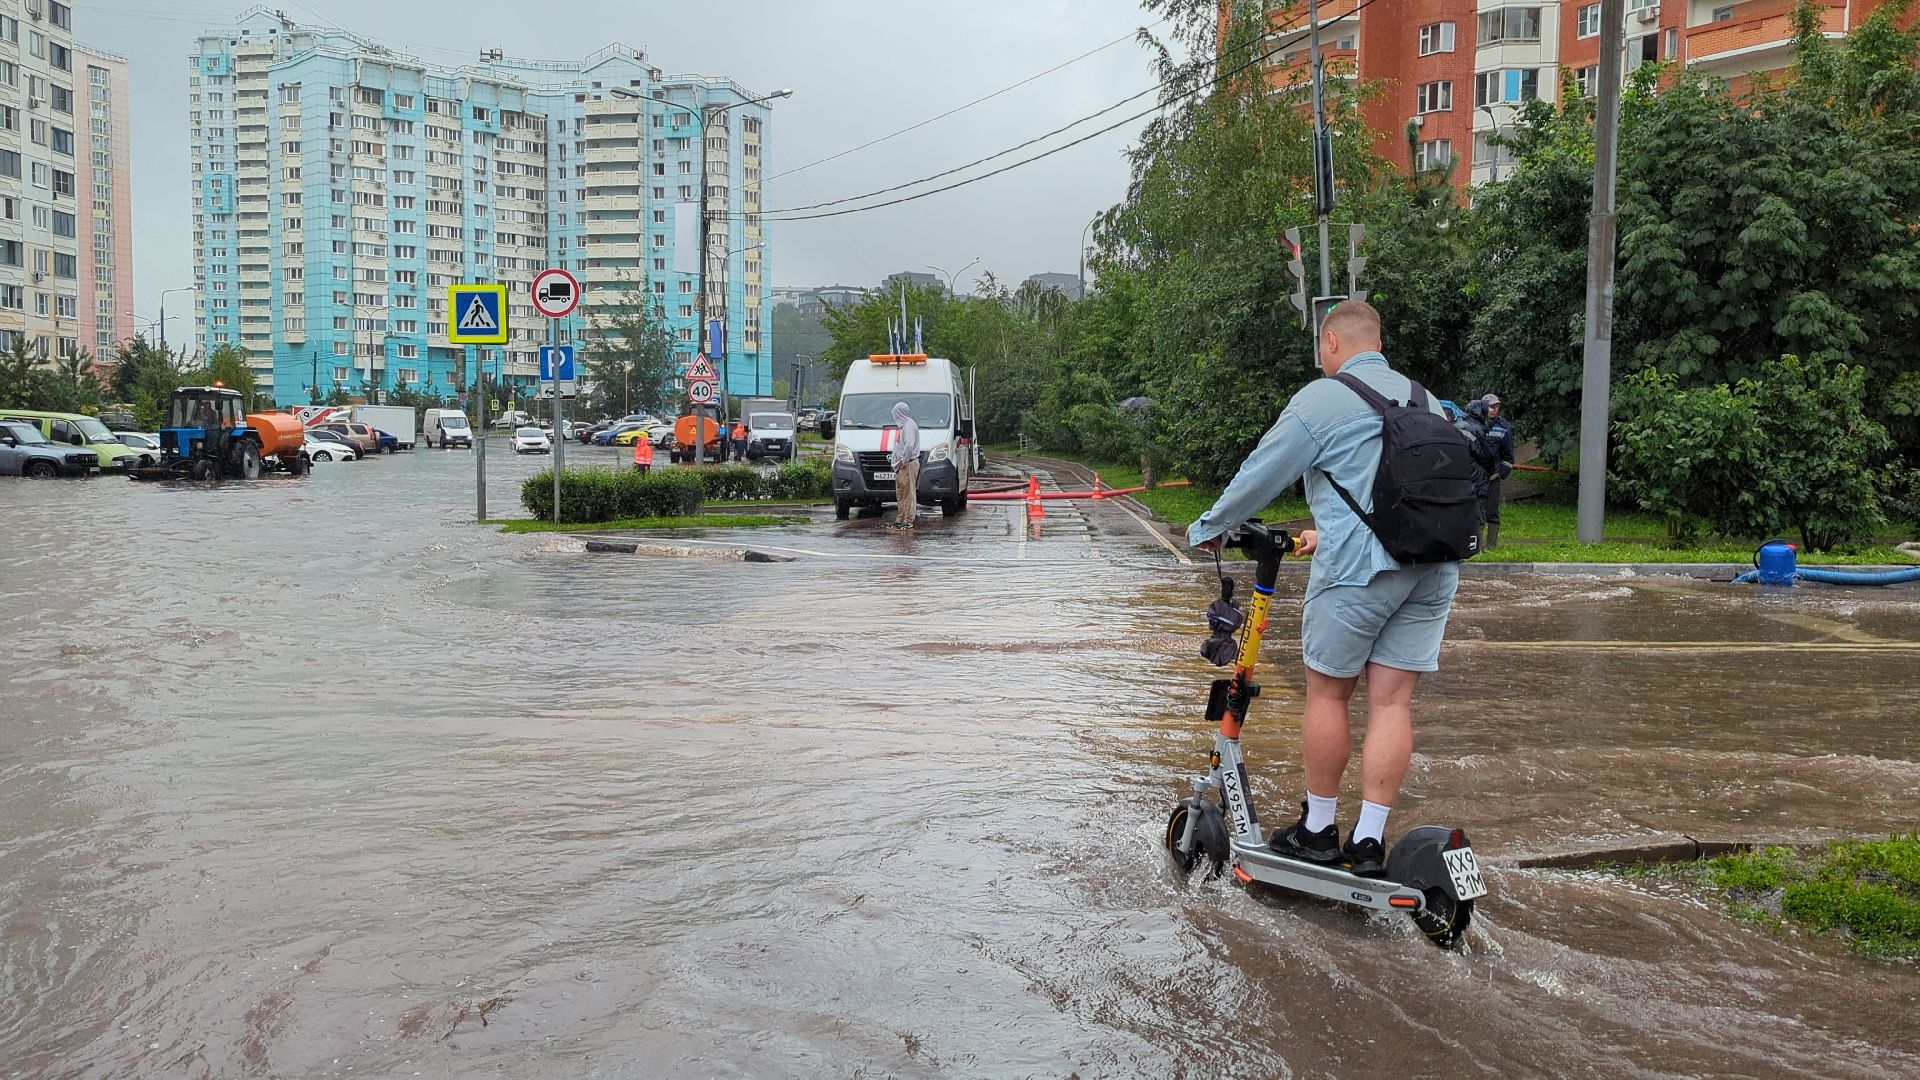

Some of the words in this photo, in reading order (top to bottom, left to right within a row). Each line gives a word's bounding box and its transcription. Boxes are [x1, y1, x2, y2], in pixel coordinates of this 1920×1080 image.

[547, 350, 566, 378] P
[692, 385, 709, 397] 40
[1238, 597, 1258, 662] WHOOSH
[1223, 771, 1249, 835] KX951M
[1445, 850, 1475, 875] KX9
[1454, 872, 1486, 897] 51M
